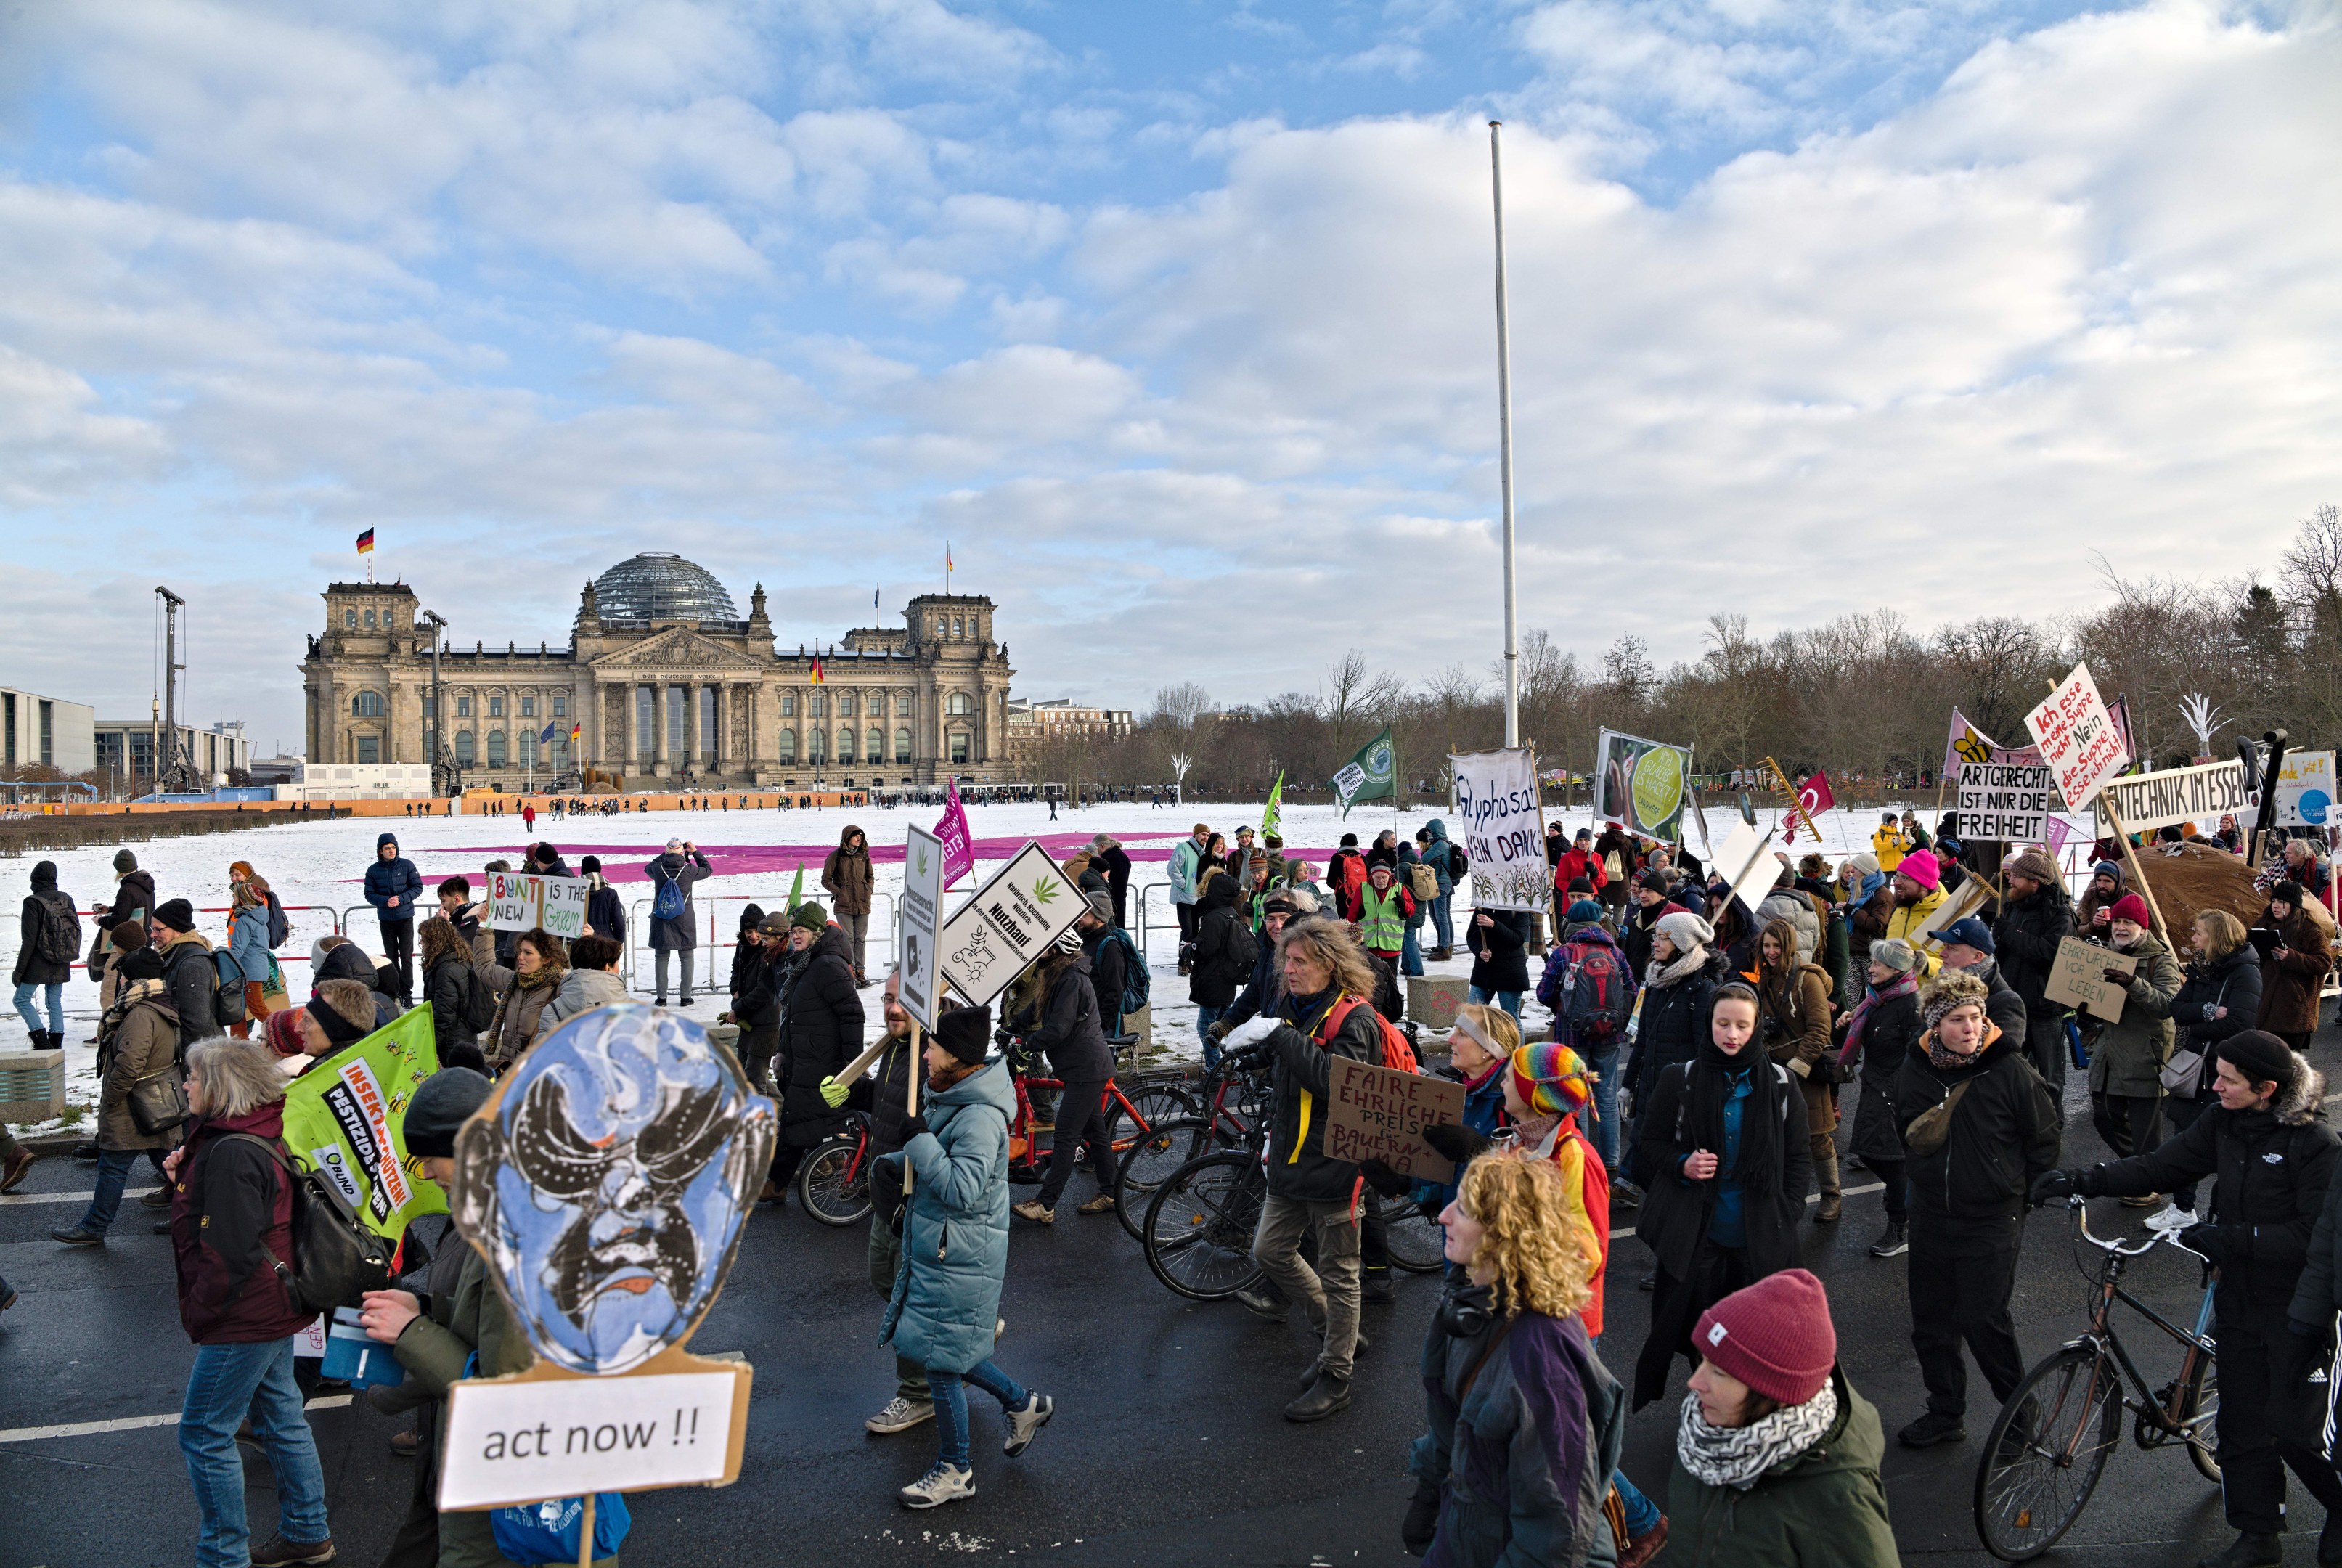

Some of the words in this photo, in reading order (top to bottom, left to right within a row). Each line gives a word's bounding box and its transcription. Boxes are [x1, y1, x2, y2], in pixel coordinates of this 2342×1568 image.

[2035, 706, 2059, 734] Ich
[2060, 681, 2083, 711] esse
[2041, 720, 2067, 753] meine
[2065, 691, 2094, 727] Suppe
[2049, 734, 2071, 764] nicht
[2073, 714, 2102, 751] Nein
[1659, 751, 1673, 767] ICH
[2062, 766, 2078, 788] die
[2078, 730, 2110, 773] Suppe
[2066, 774, 2091, 807] esse
[2091, 762, 2103, 780] ich
[2102, 734, 2123, 767] nicht
[1636, 771, 1644, 786] ES
[1646, 779, 1677, 801] HACKT!
[1960, 766, 2049, 788] ARTGERECHT
[2190, 772, 2206, 813] IM
[1960, 792, 1981, 809] IST
[1987, 792, 2016, 810] NUR
[2020, 793, 2046, 811] DIE
[1958, 814, 2042, 838] FREIHEIT
[494, 875, 539, 903] BUNT
[567, 885, 587, 902] THE
[1006, 881, 1028, 910] Natürlich,
[1026, 903, 1051, 932] Nachhaltig,
[494, 905, 523, 921] NEW
[544, 903, 583, 938] Green
[988, 902, 1032, 948] Nutzhanf
[1012, 902, 1032, 926] Nützlich:
[976, 908, 984, 918] der
[982, 914, 1003, 939] modernen
[1000, 933, 1029, 964] Landwirtschaft!
[2061, 942, 2123, 969] EHRFURCHT
[2065, 960, 2084, 975] VOR
[2093, 971, 2108, 984] DE
[2068, 978, 2106, 1002] LEBEN
[345, 1065, 384, 1136] INSEKT
[335, 1167, 354, 1196] BUND
[484, 1421, 551, 1460] act
[566, 1421, 657, 1454] now
[672, 1408, 698, 1446] !!
